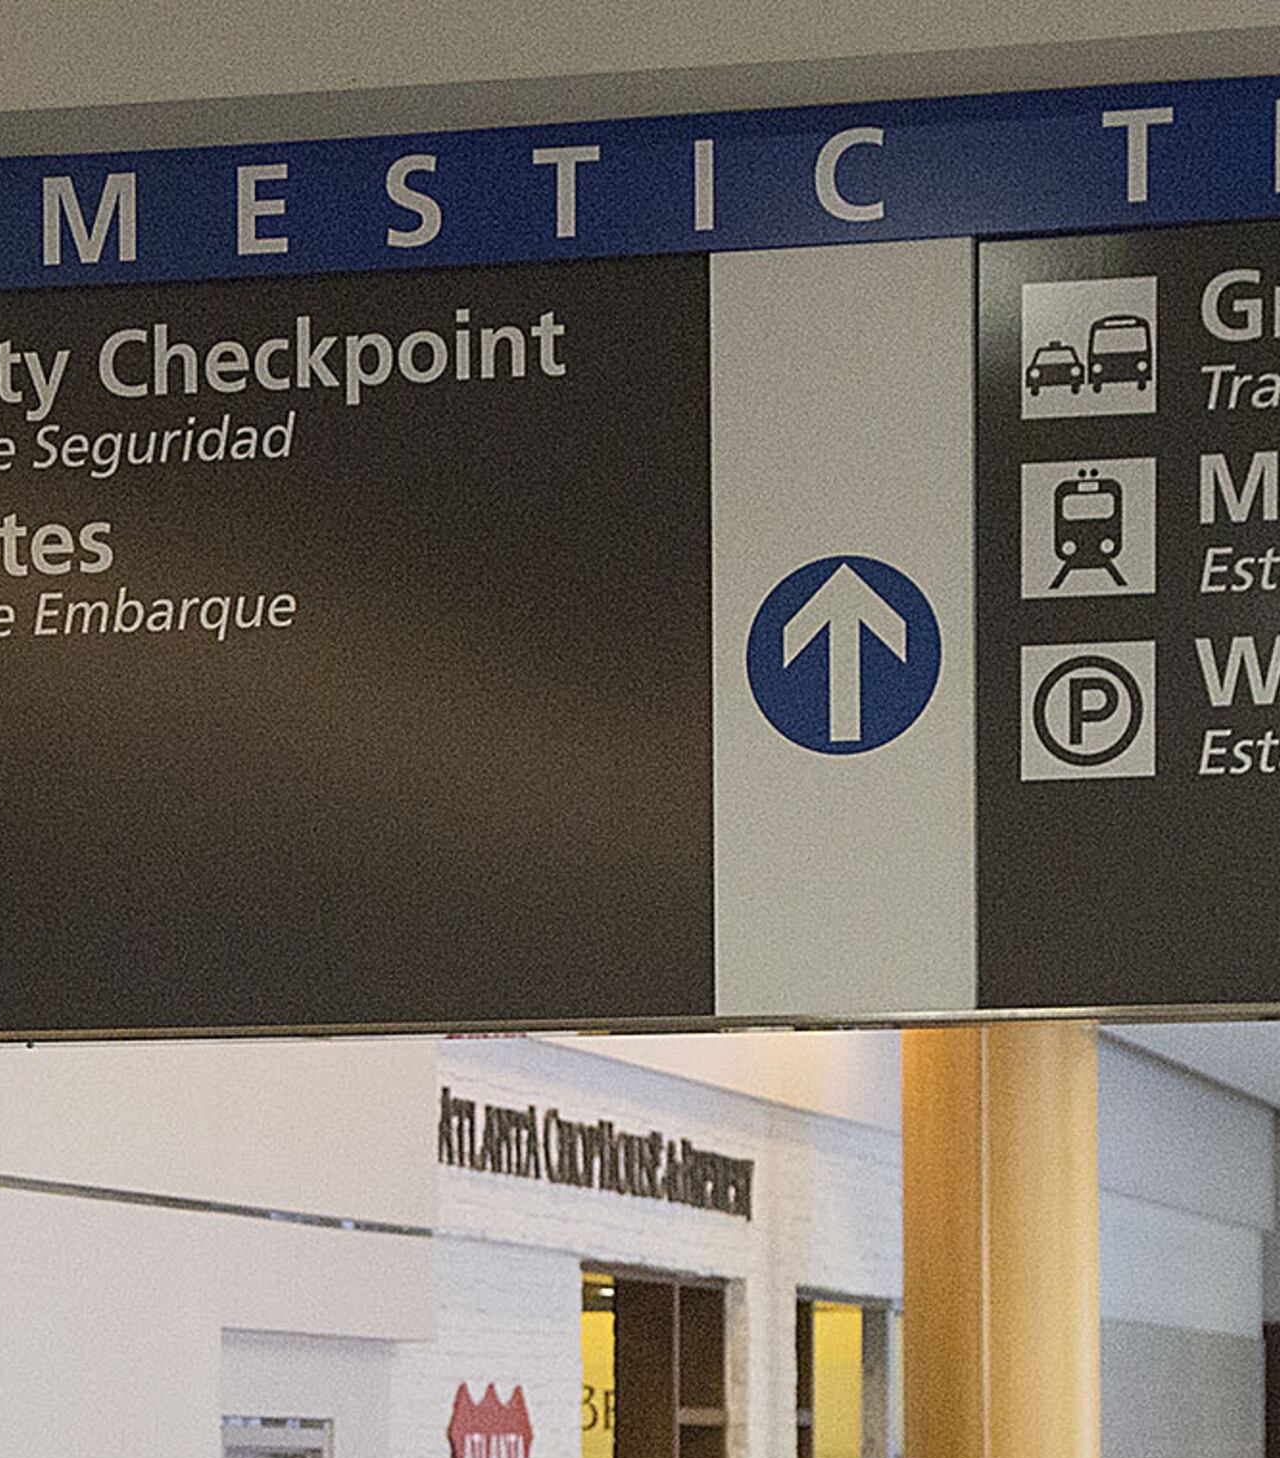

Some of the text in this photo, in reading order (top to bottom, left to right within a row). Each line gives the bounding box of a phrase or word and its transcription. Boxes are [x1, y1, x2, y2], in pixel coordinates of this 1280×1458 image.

[99, 309, 567, 405] Checkpoint
[33, 411, 298, 479] Seguridad
[34, 587, 298, 641] Embarque
